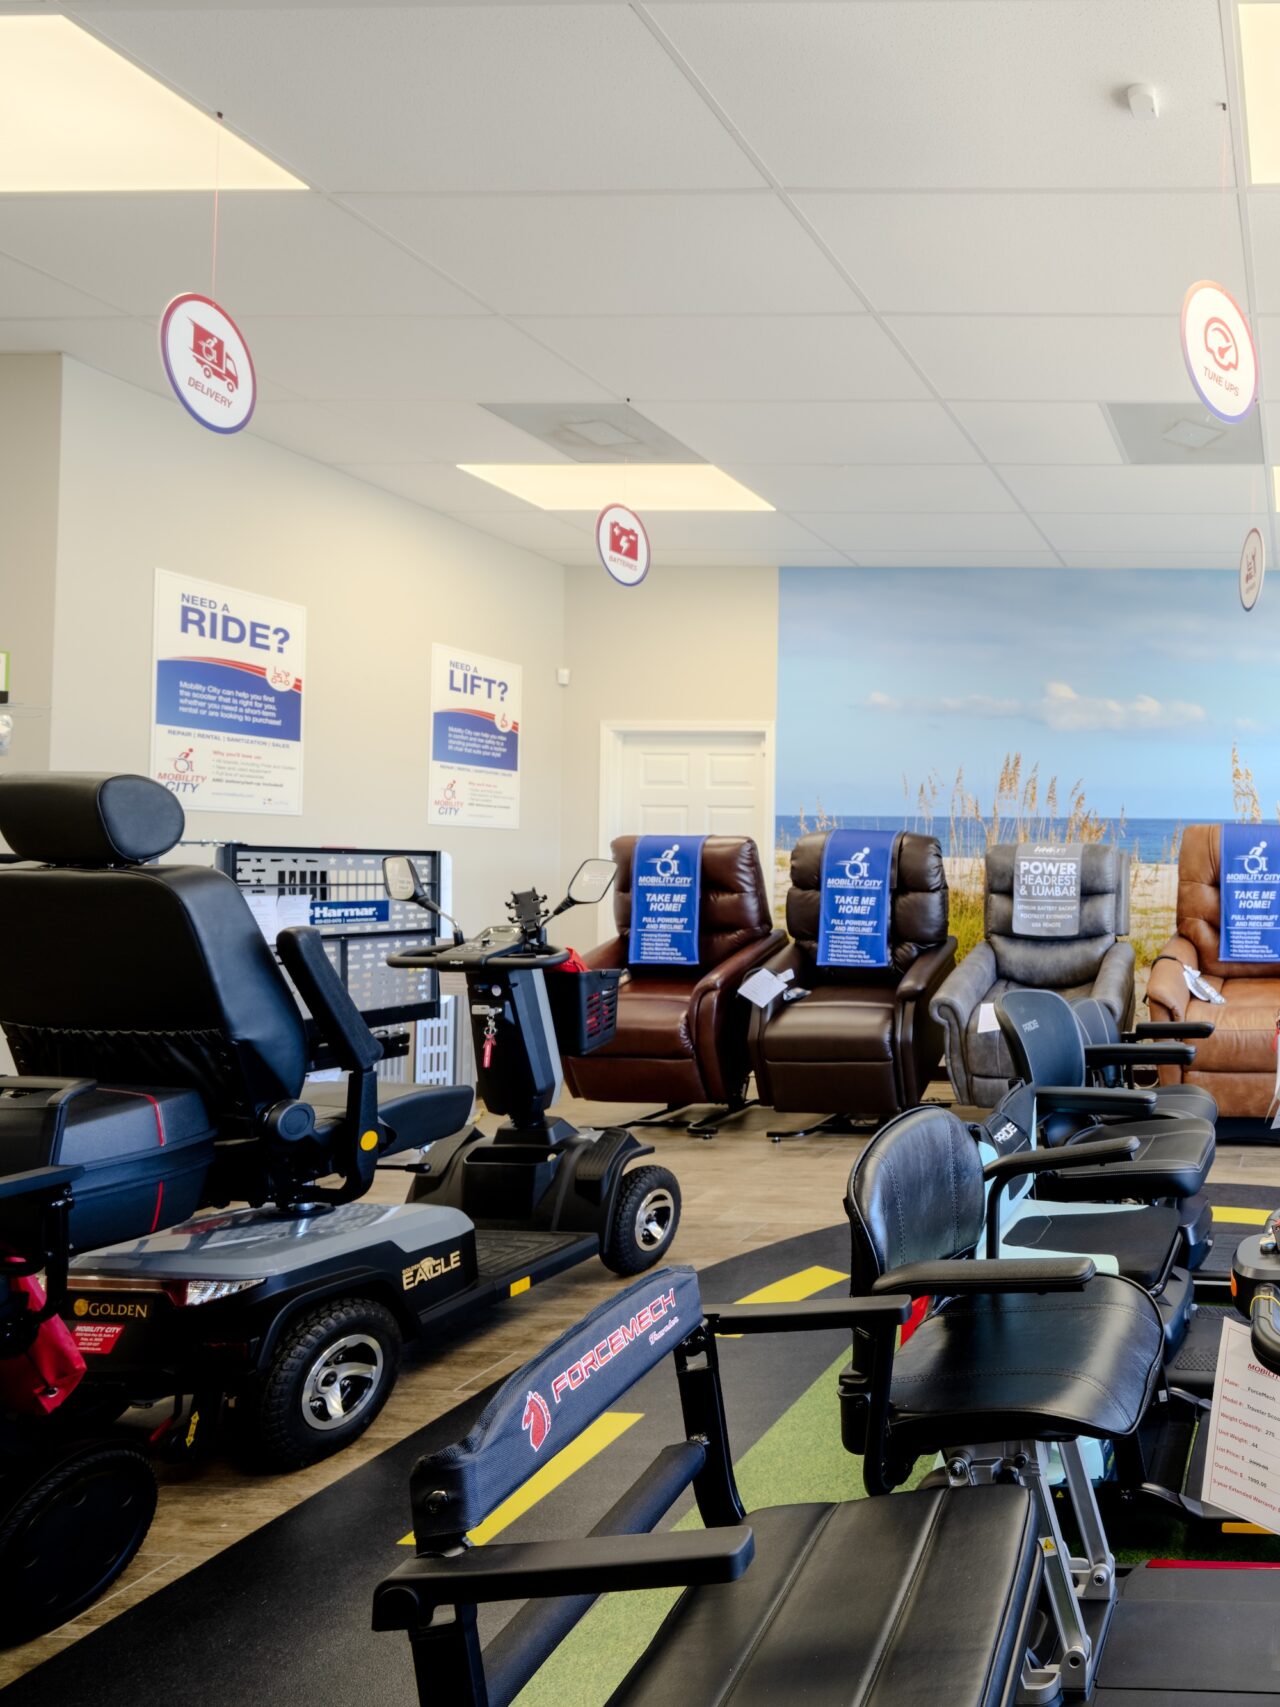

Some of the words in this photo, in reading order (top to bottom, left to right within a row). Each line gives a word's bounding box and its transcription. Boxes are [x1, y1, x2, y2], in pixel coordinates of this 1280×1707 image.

[1204, 366, 1223, 386] TUNE
[1225, 380, 1240, 396] UPS
[188, 377, 232, 408] DELIVERY
[609, 556, 637, 571] BATTERIES
[181, 593, 217, 609] NEED
[221, 603, 230, 613] A
[181, 604, 290, 654] RIDE?
[449, 660, 470, 672] NEED
[179, 680, 206, 692] Mobility
[208, 685, 220, 695] City
[235, 690, 249, 699] help
[250, 693, 262, 701] you
[263, 694, 275, 703] find
[449, 670, 508, 702] LIFT?
[179, 689, 191, 697] the
[192, 692, 217, 701] scooter
[218, 695, 230, 703] that
[239, 698, 254, 707] right
[179, 698, 206, 707] whether
[221, 703, 238, 712] need
[179, 706, 198, 714] rental
[220, 711, 243, 722] looking
[157, 772, 207, 784] MOBILITY
[165, 782, 199, 793] CITY
[438, 807, 460, 816] CITY
[1020, 862, 1077, 875] POWER
[638, 876, 674, 884] MOBILITY
[827, 878, 864, 886] MOBILITY
[1020, 875, 1076, 886] HEADREST
[1226, 873, 1264, 881] MOBILITY
[1020, 885, 1028, 896] &
[1032, 886, 1076, 896] LUMBAR
[1234, 891, 1260, 899] TAKE
[1262, 891, 1276, 899] ME
[645, 893, 671, 902] TAKE
[673, 894, 687, 903] ME
[835, 896, 860, 905] TAKE
[861, 896, 876, 906] ME
[1239, 900, 1271, 909] HOME!
[314, 906, 376, 918] Harmar
[650, 903, 682, 912] HOME!
[838, 905, 870, 914] HOME!
[1022, 1019, 1039, 1033] PRIDE
[994, 1122, 1018, 1144] PRIDE
[402, 1250, 461, 1290] EAGLE
[89, 1303, 147, 1318] GOLDEN
[552, 1288, 676, 1404] FORCEMECH
[1248, 1386, 1276, 1401] ForceMech
[1247, 1404, 1267, 1416] Traveler
[1220, 1412, 1238, 1423] Weight
[1265, 1430, 1275, 1438] 275
